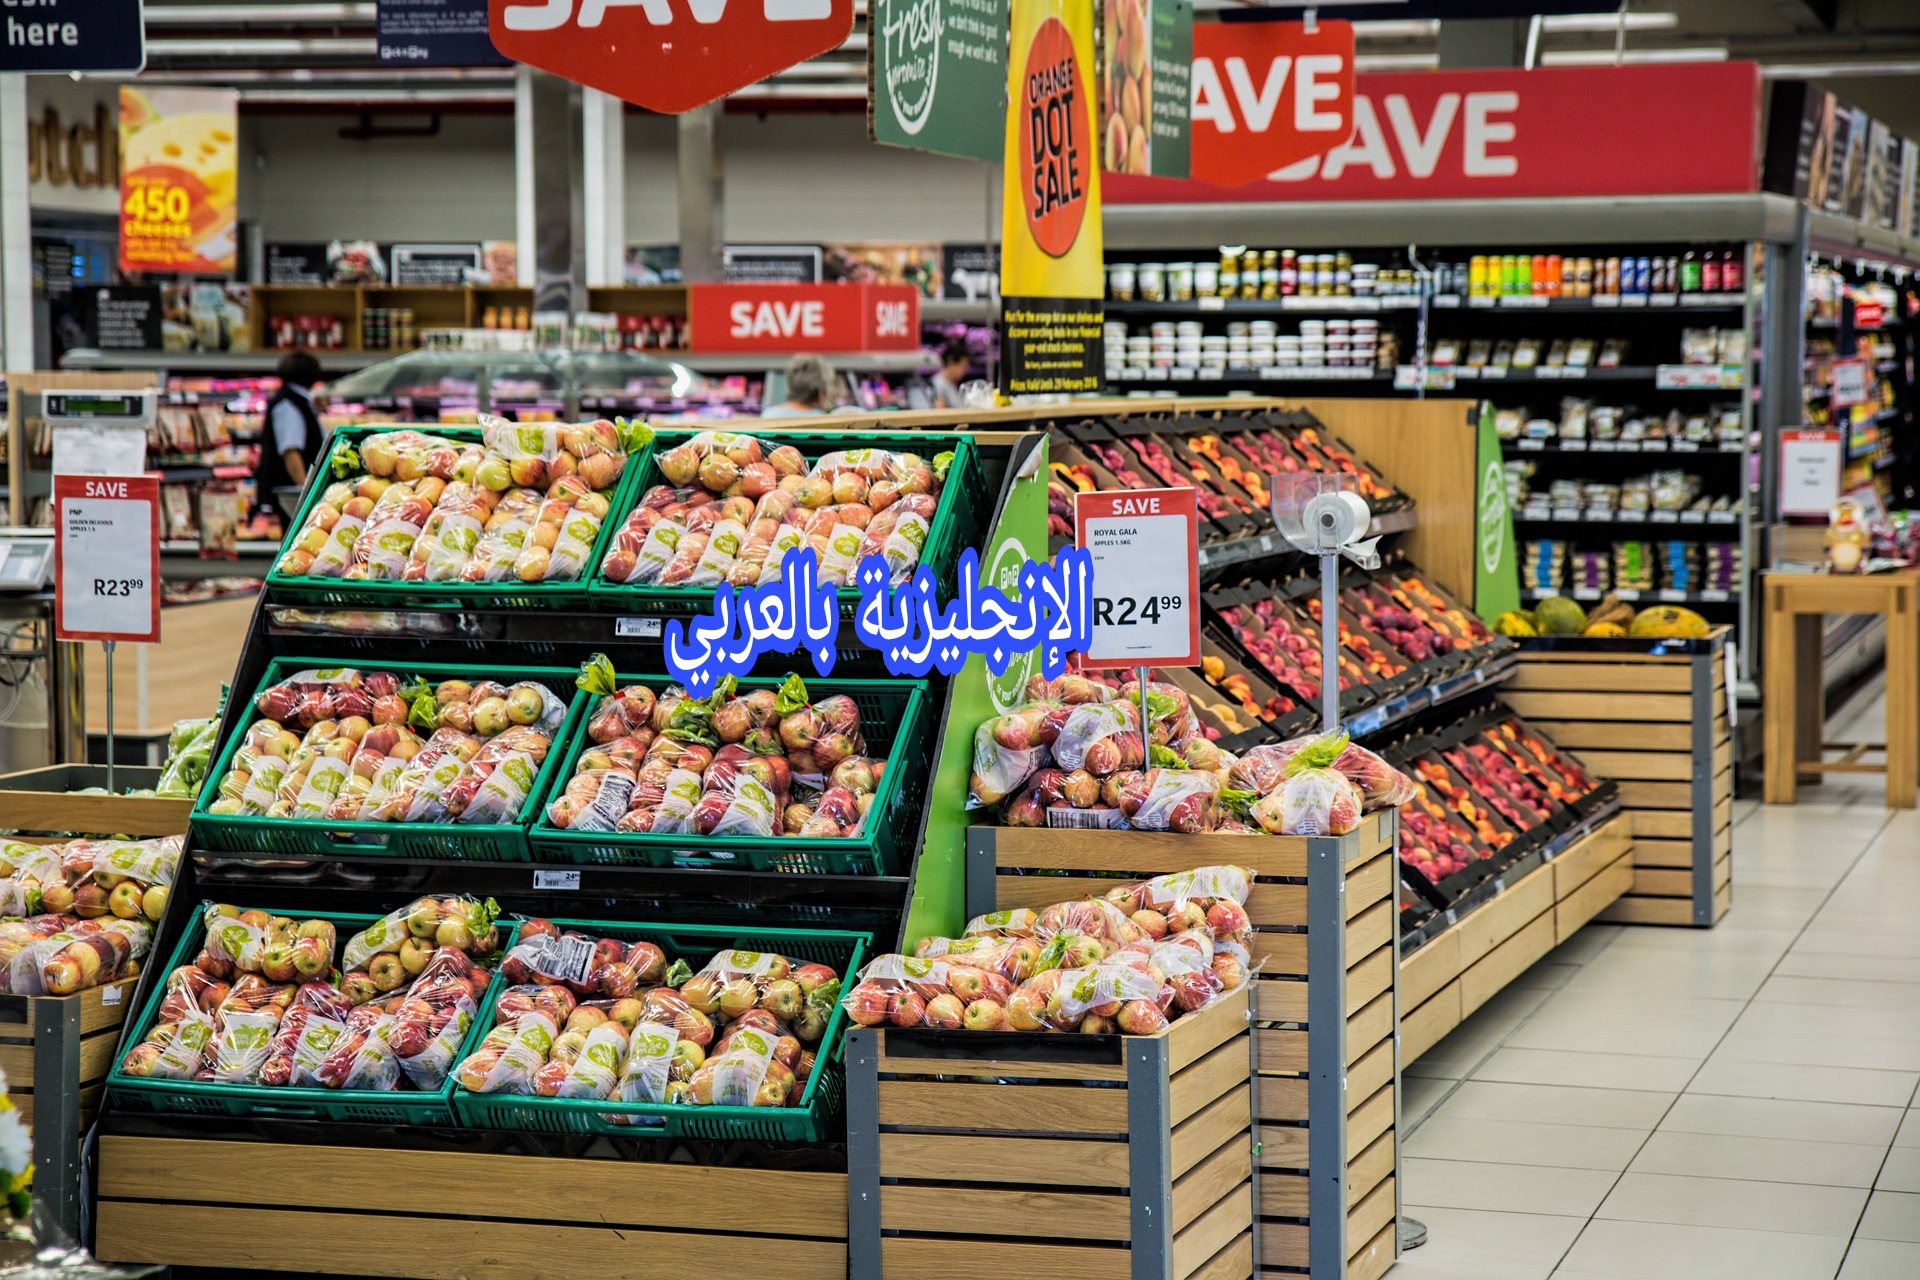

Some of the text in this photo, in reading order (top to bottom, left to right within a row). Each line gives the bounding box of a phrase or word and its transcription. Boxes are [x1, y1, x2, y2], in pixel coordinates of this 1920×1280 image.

[7, 15, 79, 46] here
[1028, 58, 1073, 104] ORANGE
[1191, 55, 1343, 132] AVE
[1030, 90, 1074, 168] DOT
[1267, 91, 1519, 180] AVE
[1032, 149, 1081, 222] SALE
[123, 187, 190, 221] 450
[730, 301, 825, 338] SAVE
[876, 301, 908, 337] SAVE
[85, 481, 128, 498] SAVE
[1112, 498, 1160, 515] SAVE
[1094, 528, 1137, 537] ROYAL GALA
